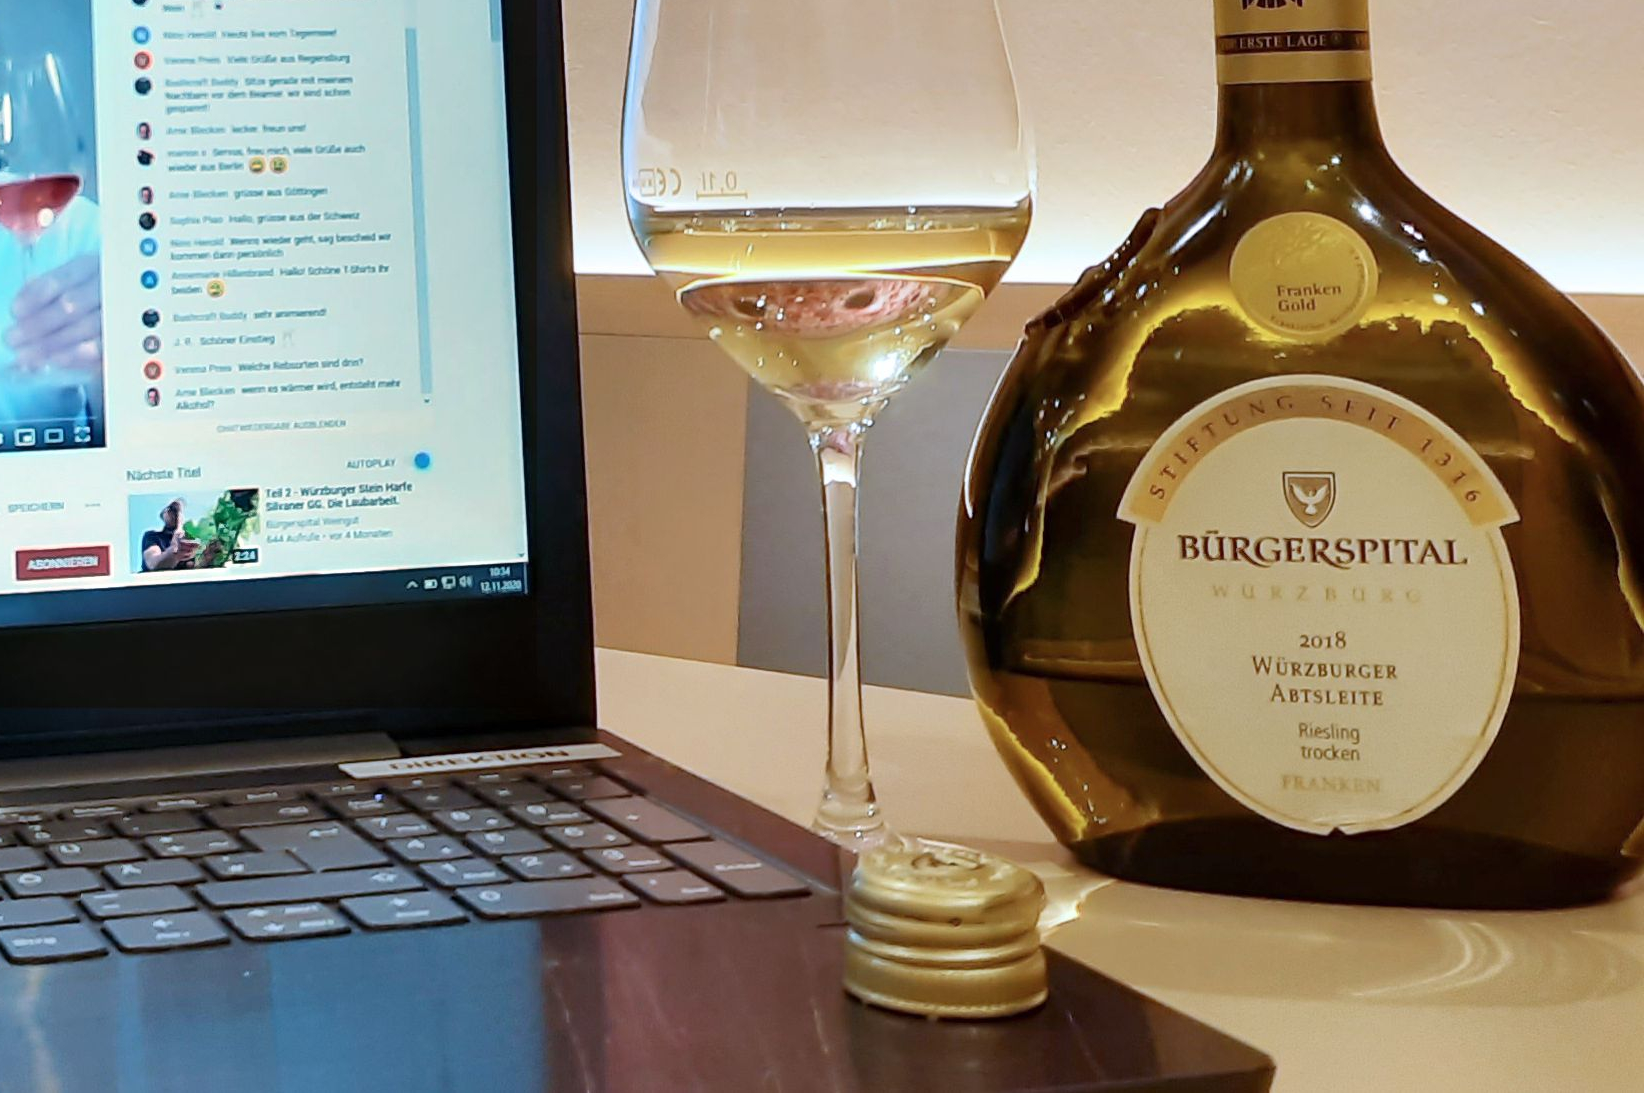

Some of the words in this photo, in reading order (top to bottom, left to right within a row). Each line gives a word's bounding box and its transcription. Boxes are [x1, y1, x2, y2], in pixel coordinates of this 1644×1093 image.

[1239, 35, 1281, 50] ERSTE
[1286, 33, 1327, 48] LAGE
[298, 54, 350, 65] Regensburg
[308, 212, 321, 221] der
[1276, 283, 1342, 297] Franken
[1277, 299, 1316, 312] Gold
[239, 334, 275, 345] Einstieg
[273, 361, 318, 370] Rebsorten
[321, 359, 340, 368] sind
[1149, 394, 1295, 500] STIFTUNG
[1320, 394, 1399, 431] SEIT
[1419, 437, 1482, 505] 1316
[347, 458, 396, 469] AUTOPLAY
[285, 488, 291, 497] 2
[1177, 530, 1468, 570] BÜRGERSPITAL
[1299, 631, 1347, 650] 2018
[1270, 684, 1384, 707] ABTSLEITE
[1298, 721, 1361, 745] Riesling
[1301, 744, 1361, 762] trocken
[1280, 773, 1383, 795] FRANKEN
